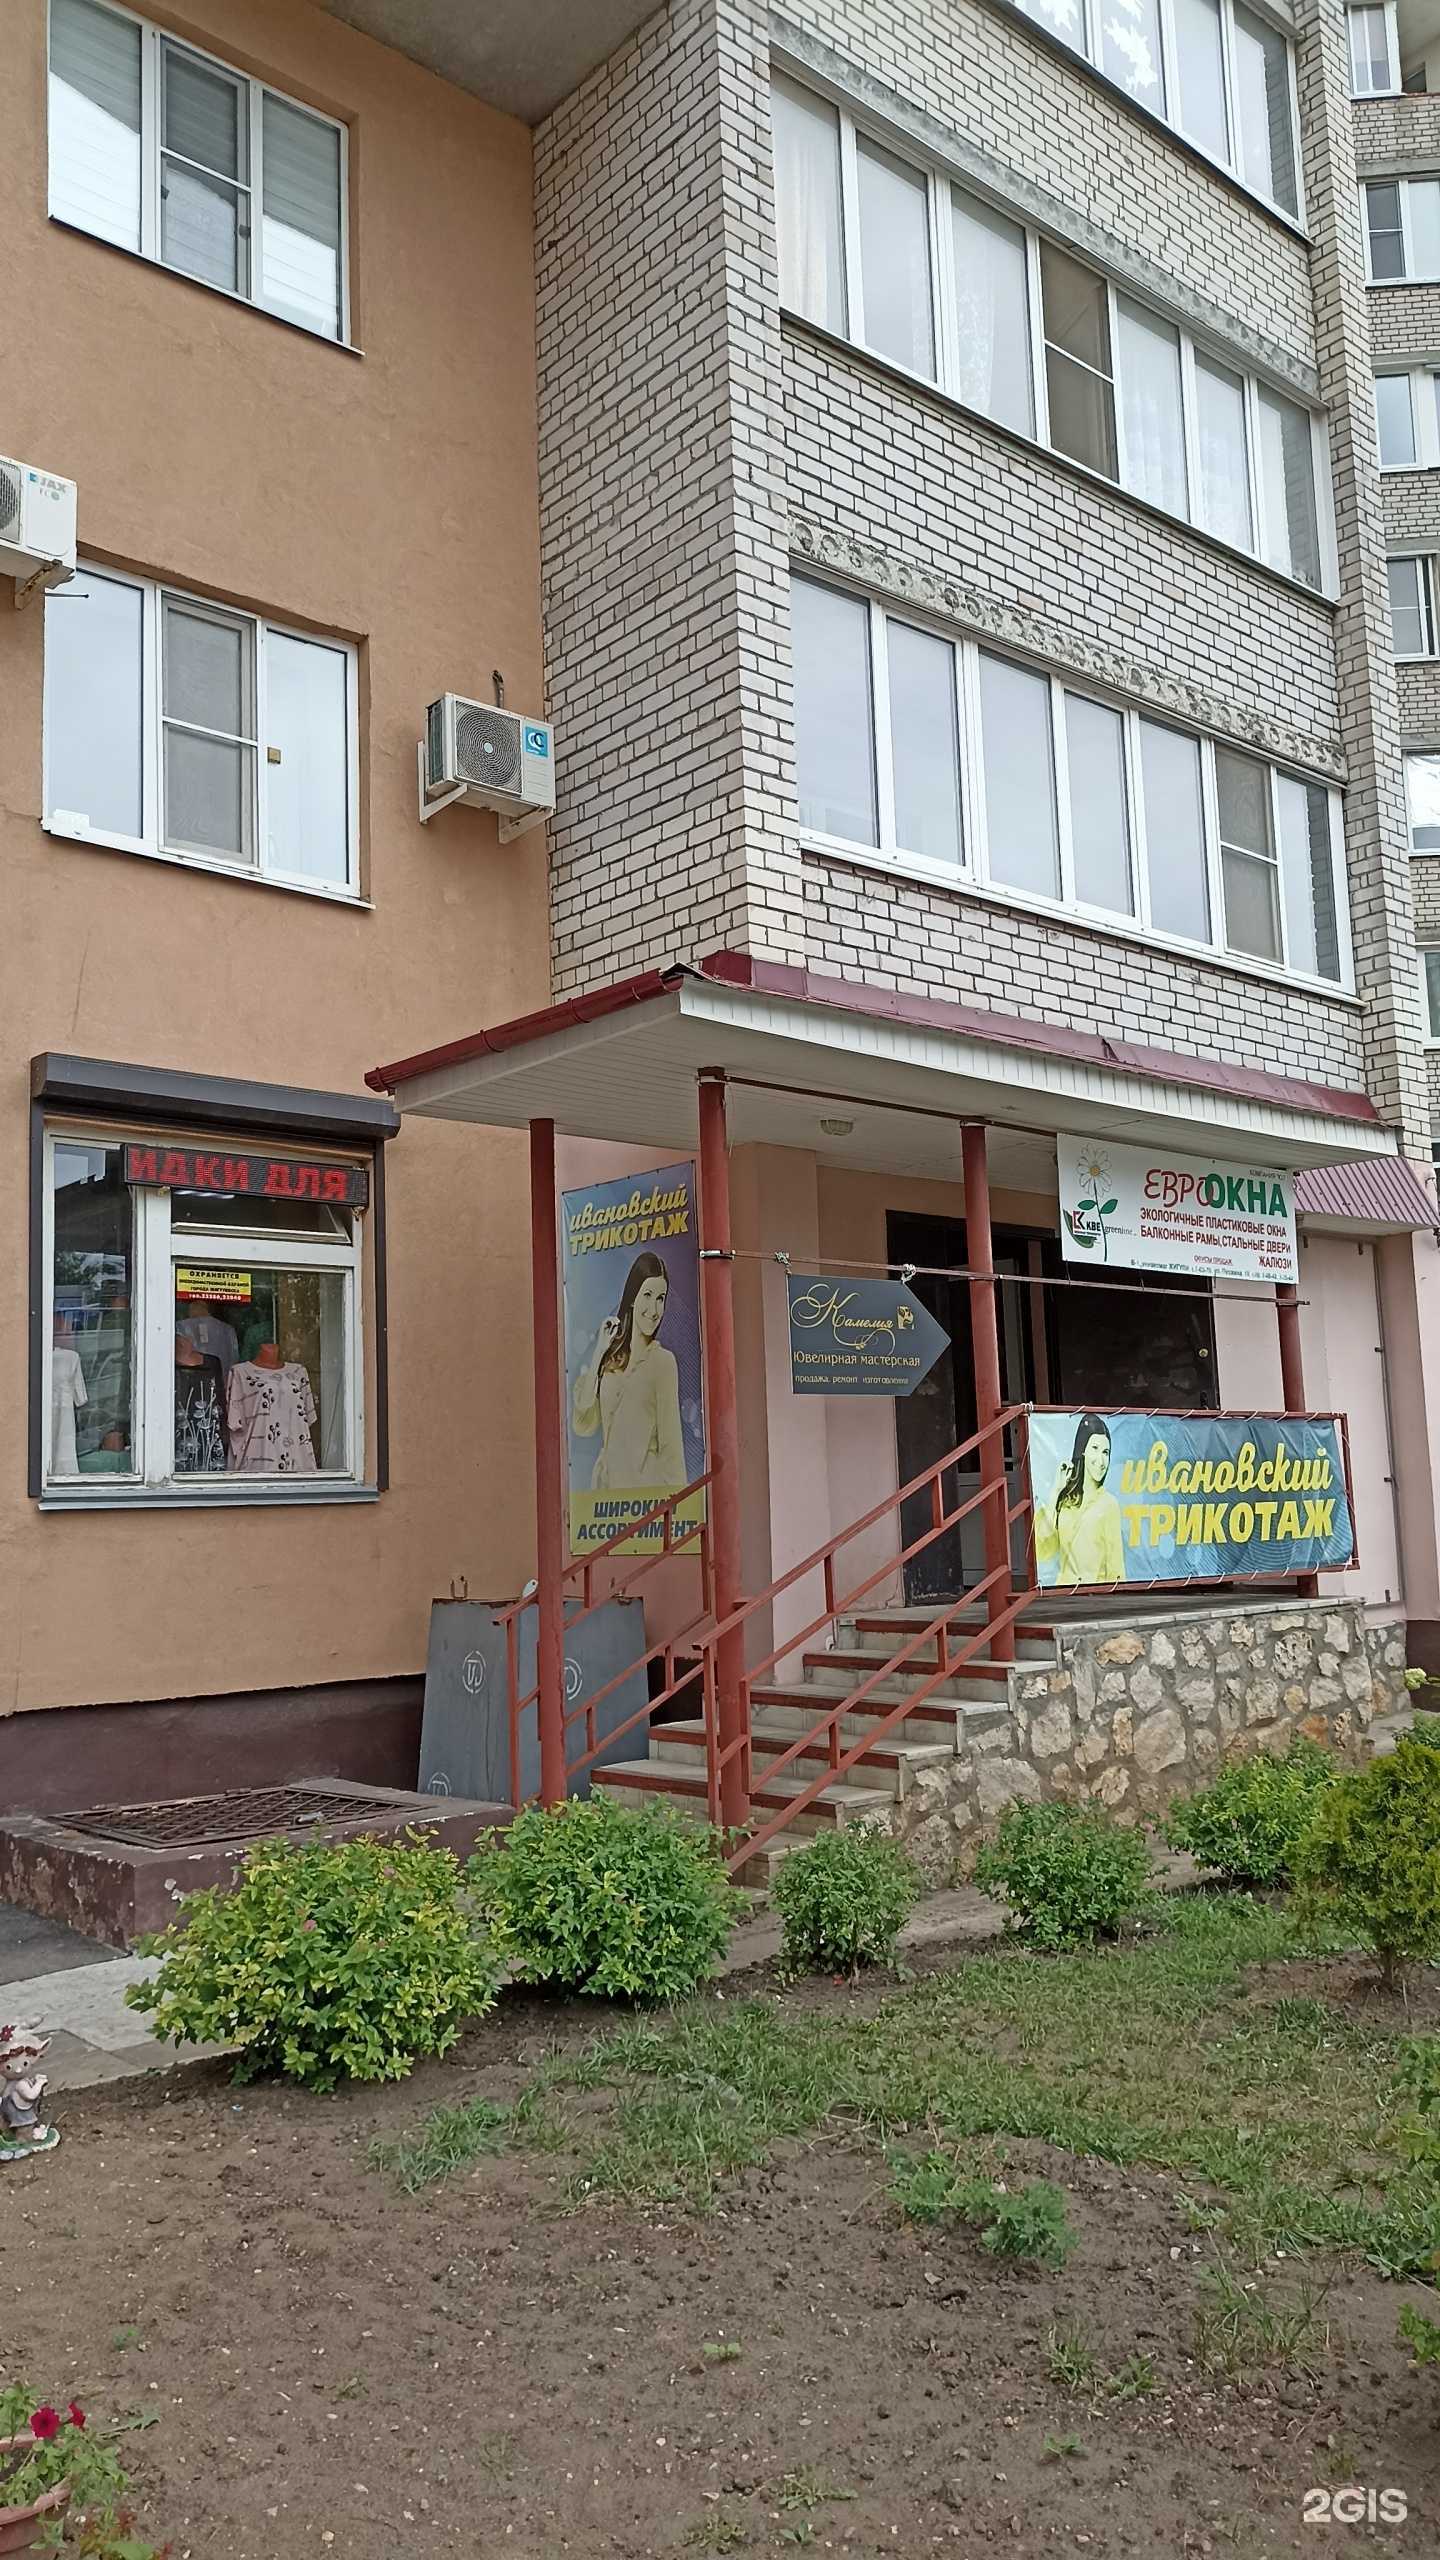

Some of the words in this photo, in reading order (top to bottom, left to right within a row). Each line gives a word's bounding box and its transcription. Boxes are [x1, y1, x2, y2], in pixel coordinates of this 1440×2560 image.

[129, 1147, 249, 1191] ИДКИ
[264, 1162, 347, 1201] ДЛЯ
[569, 1183, 688, 1233] ивановский
[1140, 1207, 1204, 1227] ЭКОЛОГИЧНЫЕ
[1205, 1216, 1265, 1233] ПЛАСТИКОВЫЕ
[1266, 1224, 1287, 1237] ОКНА
[569, 1209, 690, 1257] ТРИКОТАЖ
[1140, 1226, 1193, 1243] БАЛКОННЫЕ
[1266, 1241, 1291, 1254] ДВЕРИ
[189, 1270, 239, 1279] ОХРАНЯЕТСЯ
[1258, 1255, 1292, 1269] ЖАЛЮЗИ
[790, 1283, 895, 1346] Камелия
[793, 1350, 857, 1366] Ювелирная
[860, 1354, 921, 1368] мастерская
[1120, 1440, 1333, 1494] ивановский
[1121, 1498, 1337, 1547] ТРИКОТАЖ
